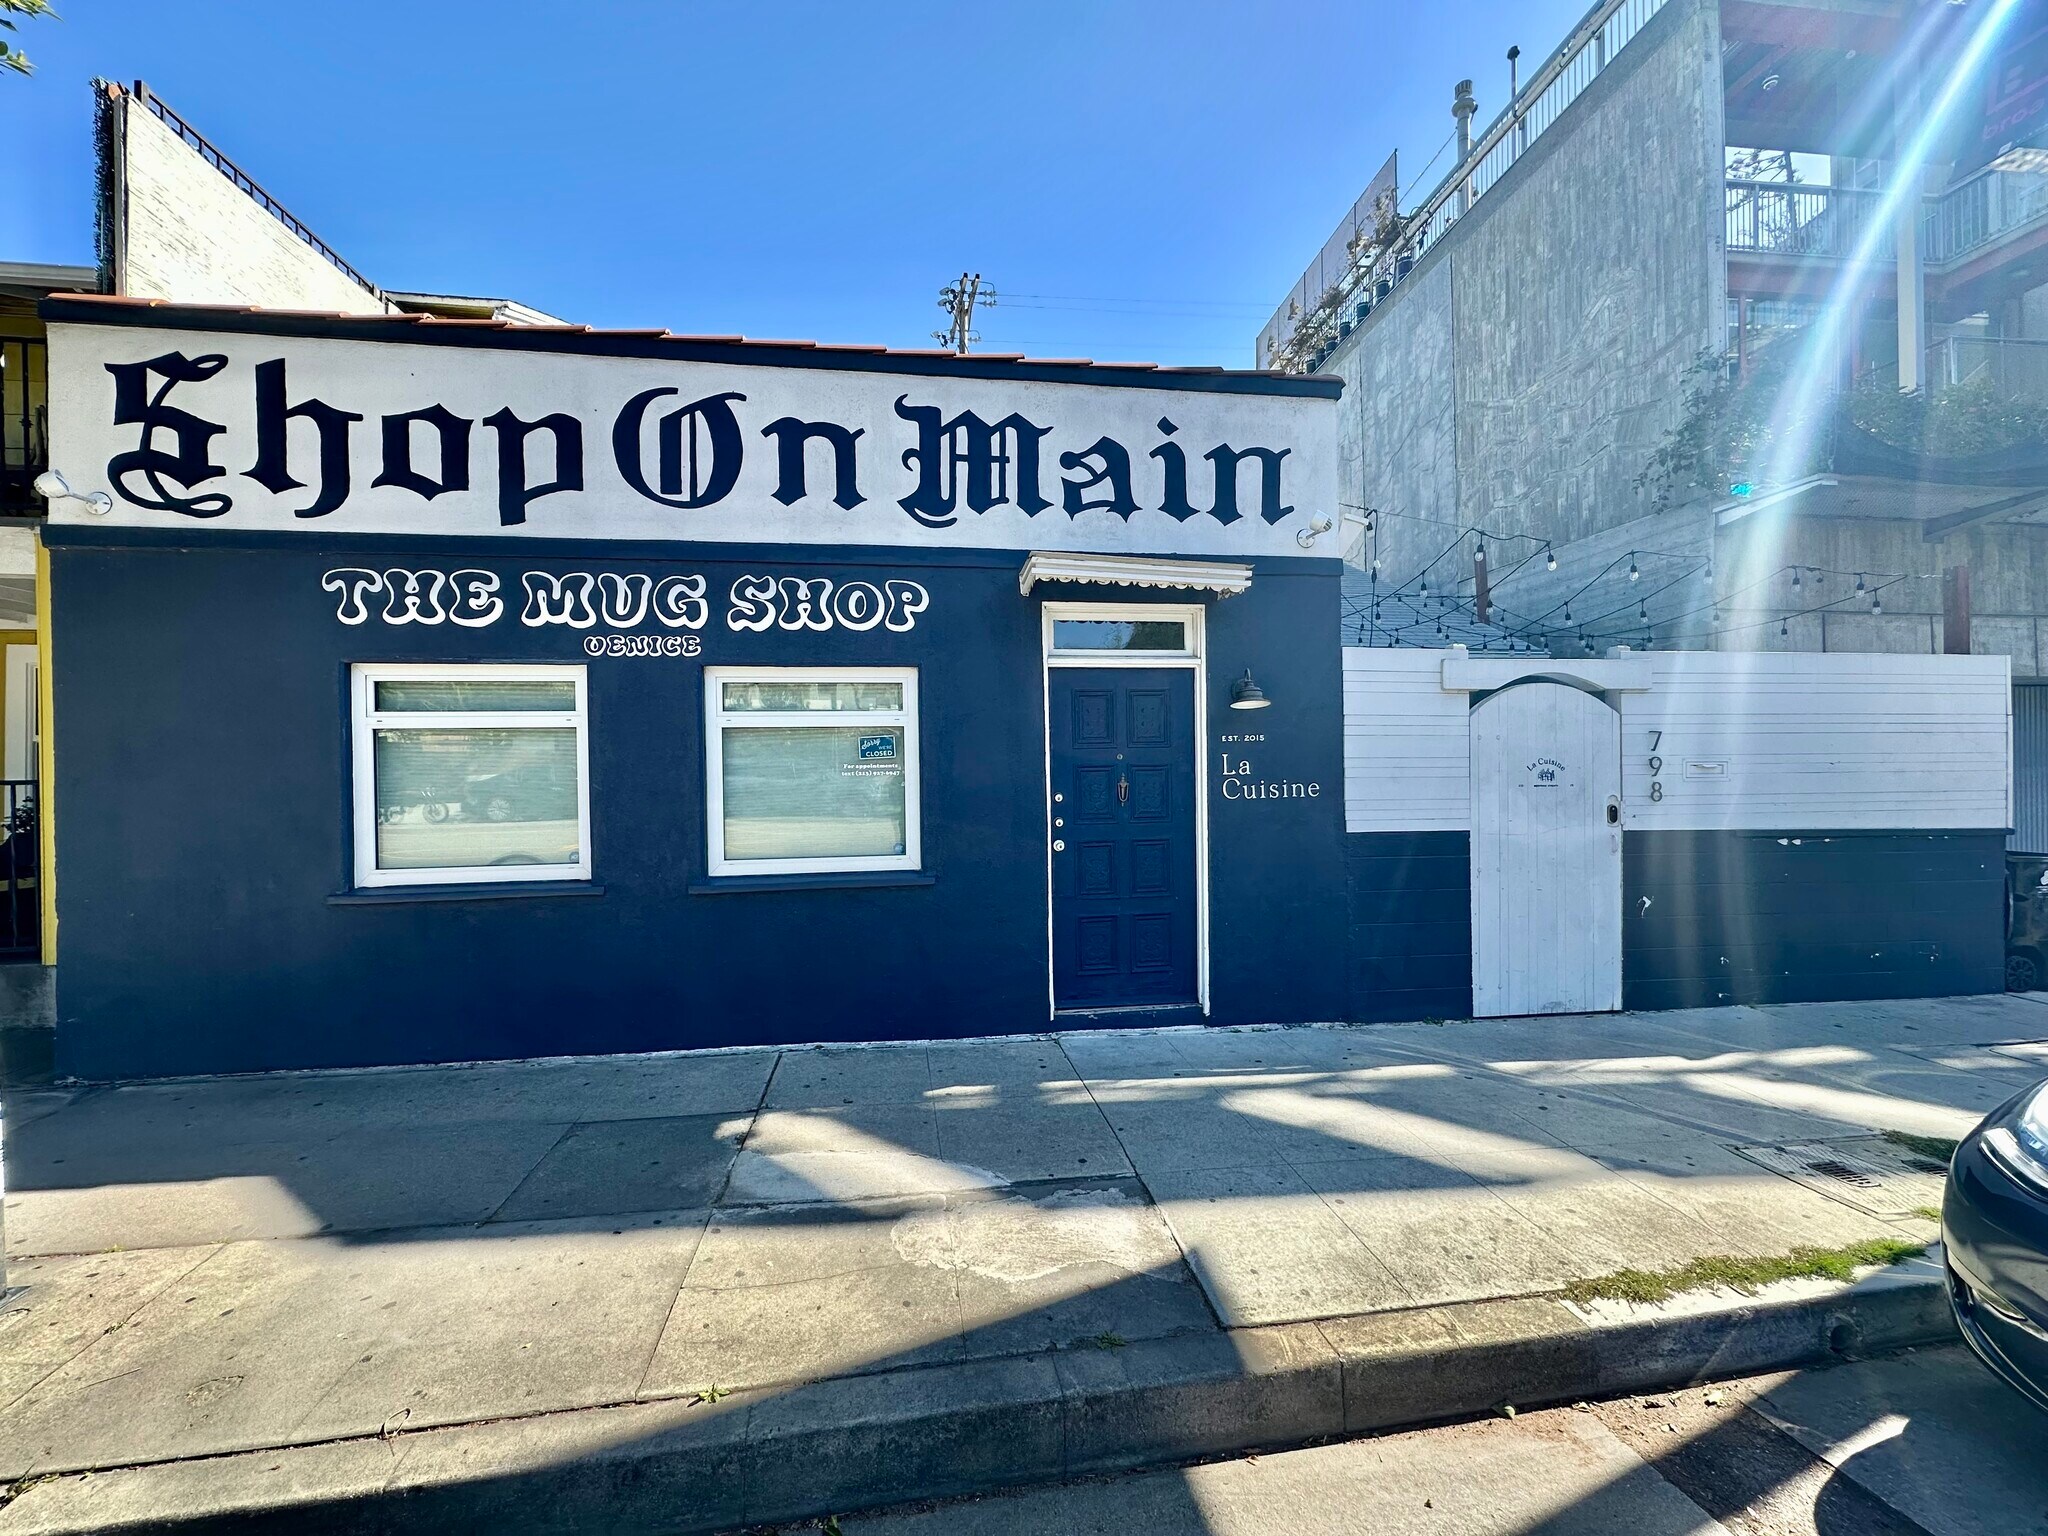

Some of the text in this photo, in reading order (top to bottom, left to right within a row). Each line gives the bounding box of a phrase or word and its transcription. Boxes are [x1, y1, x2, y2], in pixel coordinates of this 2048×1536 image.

[104, 351, 1295, 529] Shop On Main
[321, 567, 930, 633] THE MUG SHOP
[583, 634, 702, 657] VENICE
[1244, 734, 1265, 742] 2015
[1221, 753, 1251, 775] La
[1526, 757, 1566, 772] La Cuisine
[1222, 778, 1320, 799] Cuisine
